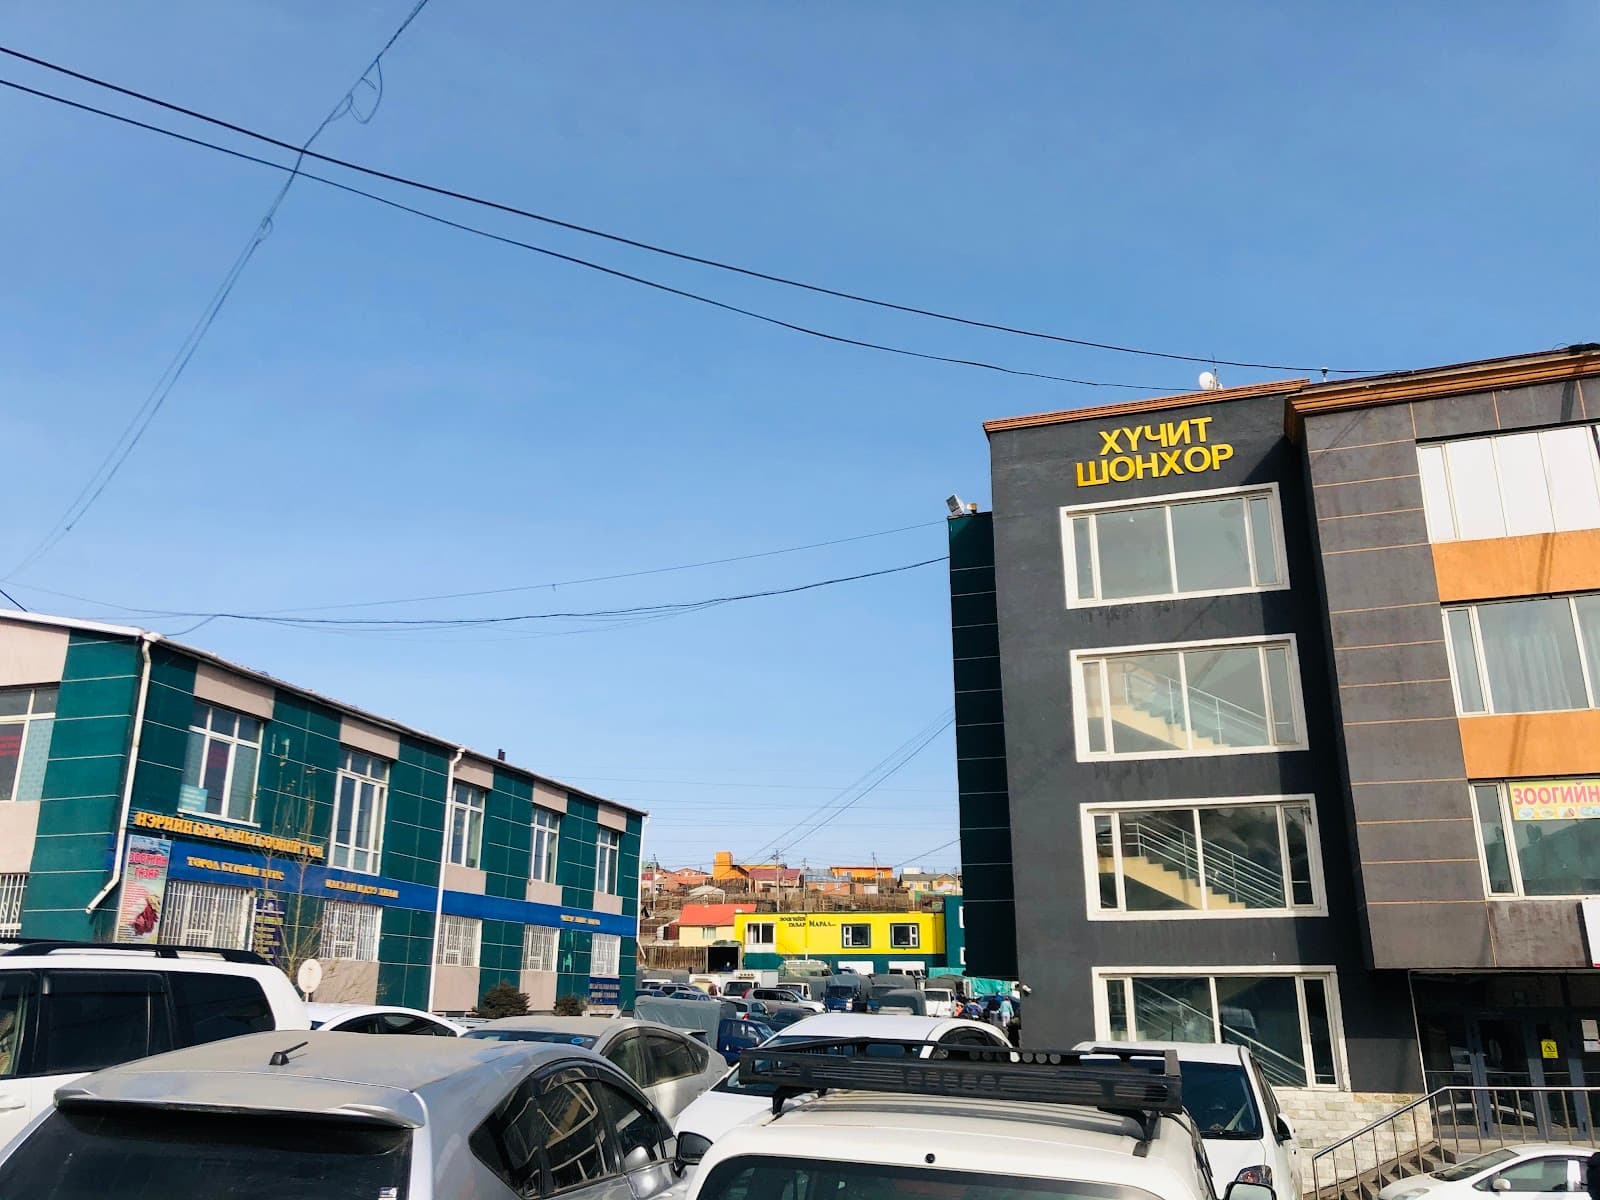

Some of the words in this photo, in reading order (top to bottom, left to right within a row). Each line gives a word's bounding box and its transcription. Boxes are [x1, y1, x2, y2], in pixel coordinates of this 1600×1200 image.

[1099, 417, 1212, 456] ХҮЧИТ
[1076, 444, 1234, 487] ШОНХОР
[1513, 781, 1600, 805] ЗООГИЙН
